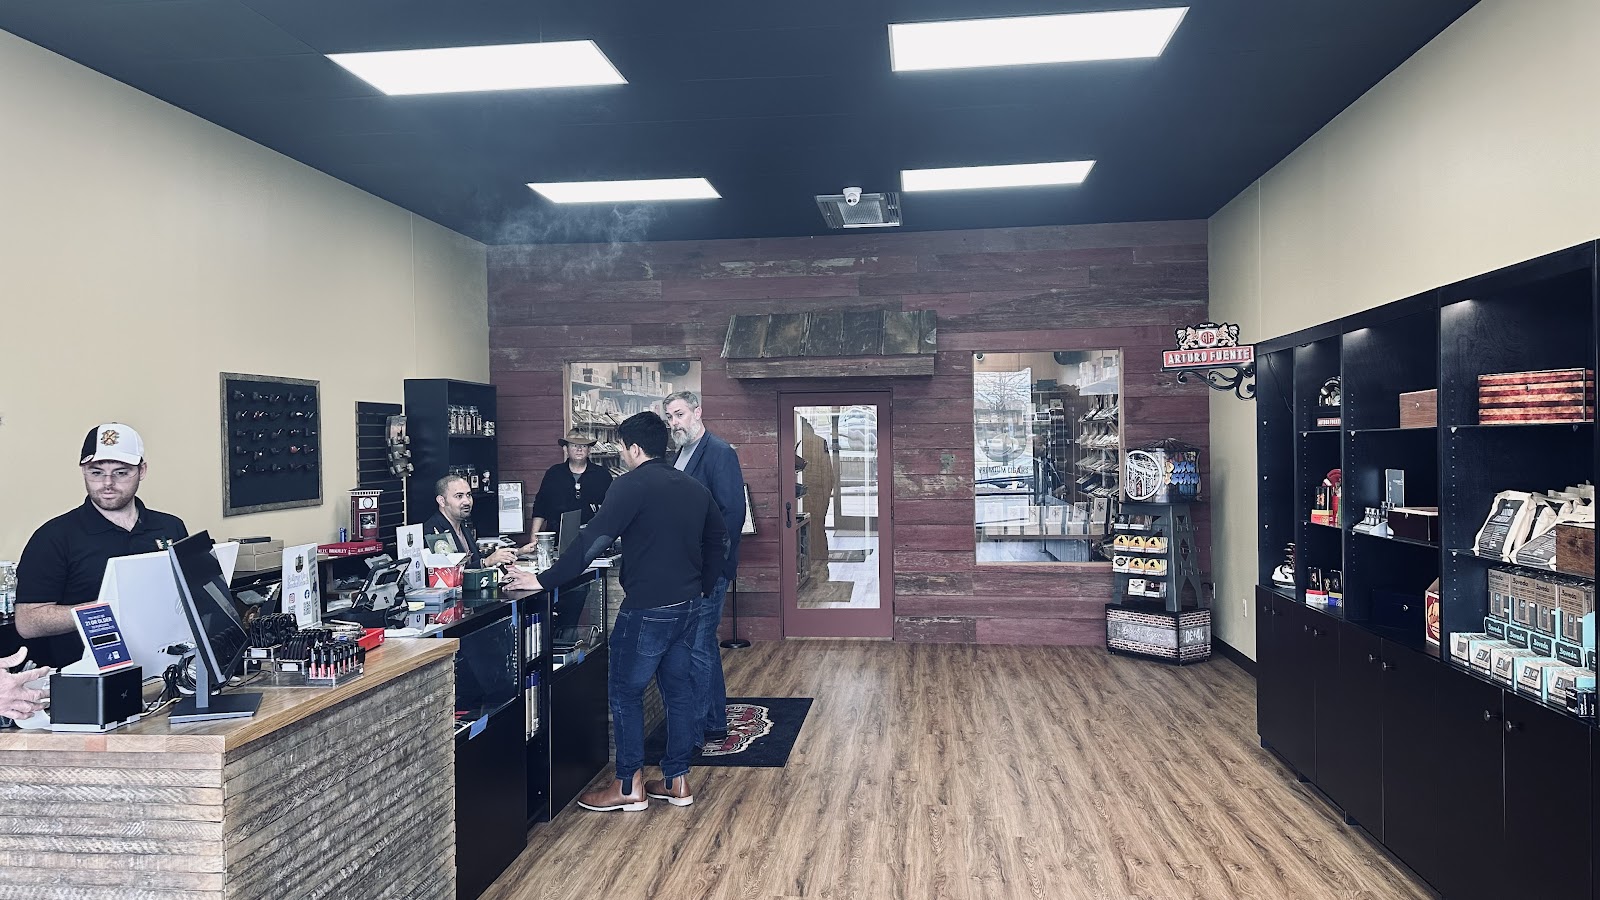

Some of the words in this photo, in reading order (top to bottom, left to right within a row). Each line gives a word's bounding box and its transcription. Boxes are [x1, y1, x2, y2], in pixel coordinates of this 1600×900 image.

[1168, 352, 1207, 364] ARTURO
[1210, 348, 1250, 360] FUENTE
[1512, 578, 1528, 587] Boveda
[1487, 623, 1502, 634] Boveda
[1509, 630, 1525, 642] Boveda
[1533, 638, 1549, 650] Boveda
[1560, 647, 1577, 658] Boveda
